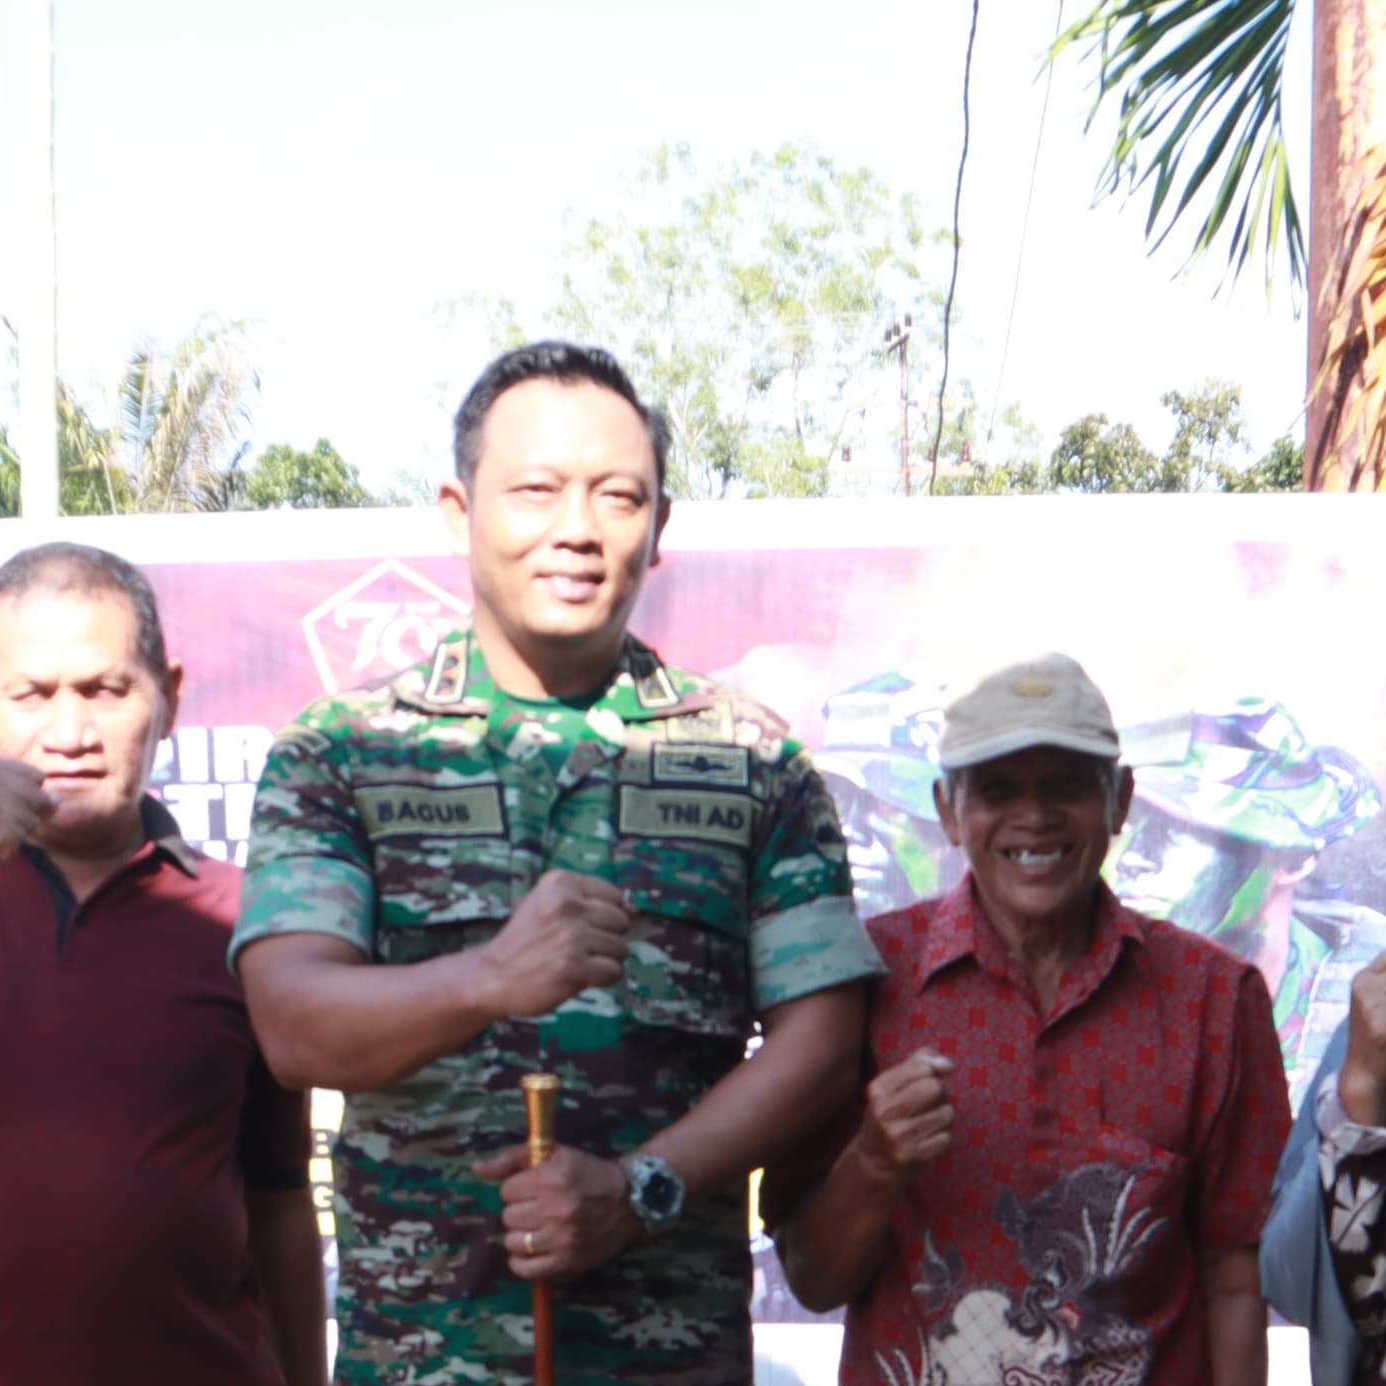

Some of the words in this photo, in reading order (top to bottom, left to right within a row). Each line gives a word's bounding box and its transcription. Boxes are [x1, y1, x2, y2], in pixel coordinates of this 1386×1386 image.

[376, 800, 470, 823] BAGUS
[657, 802, 701, 825] TNI
[706, 805, 745, 830] AD
